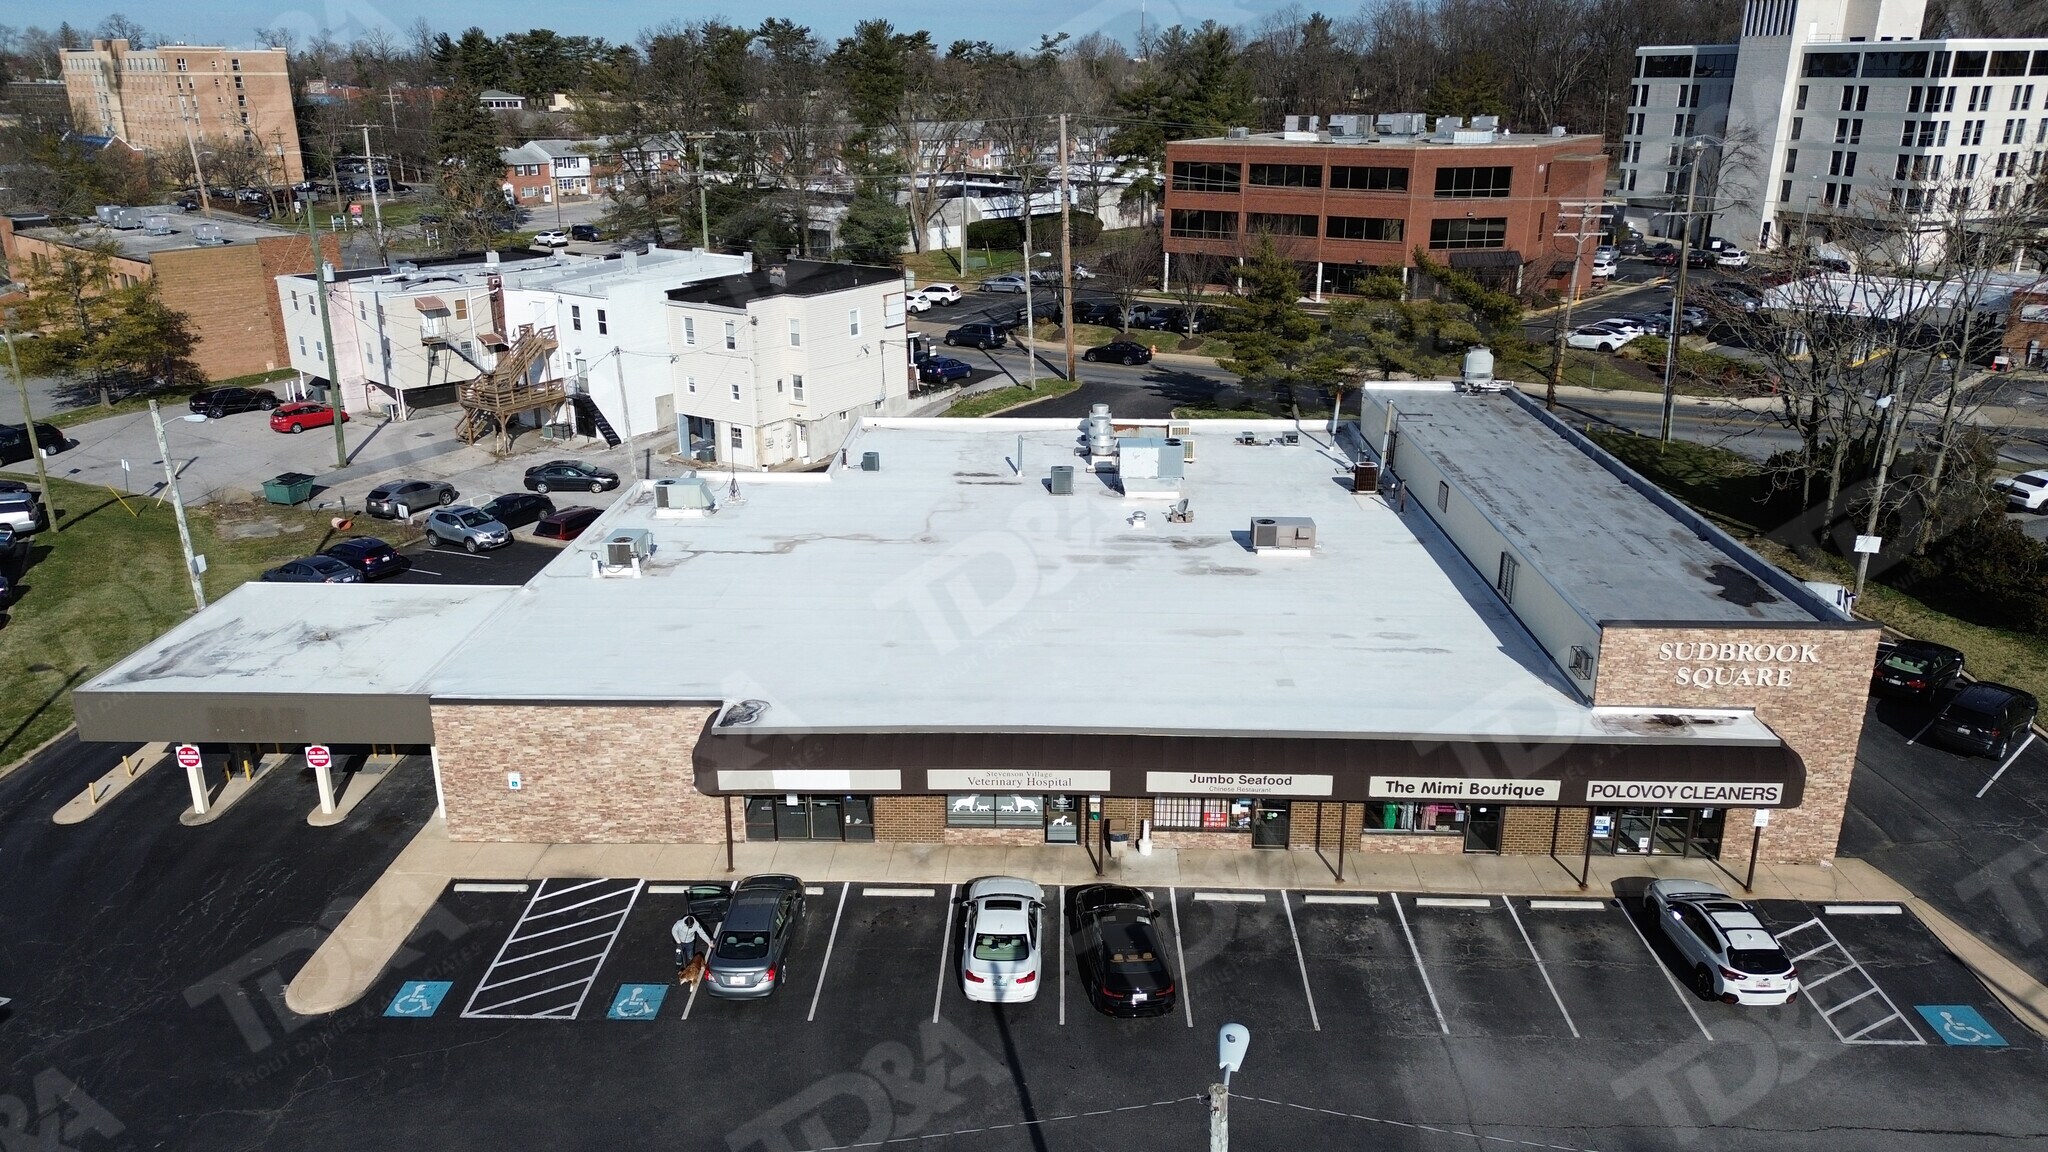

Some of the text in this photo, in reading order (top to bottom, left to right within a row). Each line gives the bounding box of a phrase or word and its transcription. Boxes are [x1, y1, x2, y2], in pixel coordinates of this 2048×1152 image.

[1659, 642, 1821, 663] SUDBROOK
[1675, 666, 1793, 688] SQUARE
[967, 776, 1072, 788] Veterinary Hospital
[1189, 774, 1293, 786] Jumbo Seafood
[1385, 780, 1545, 798] The Mimi Boutique
[1591, 784, 1778, 801] POLOVOY CLEANERS
